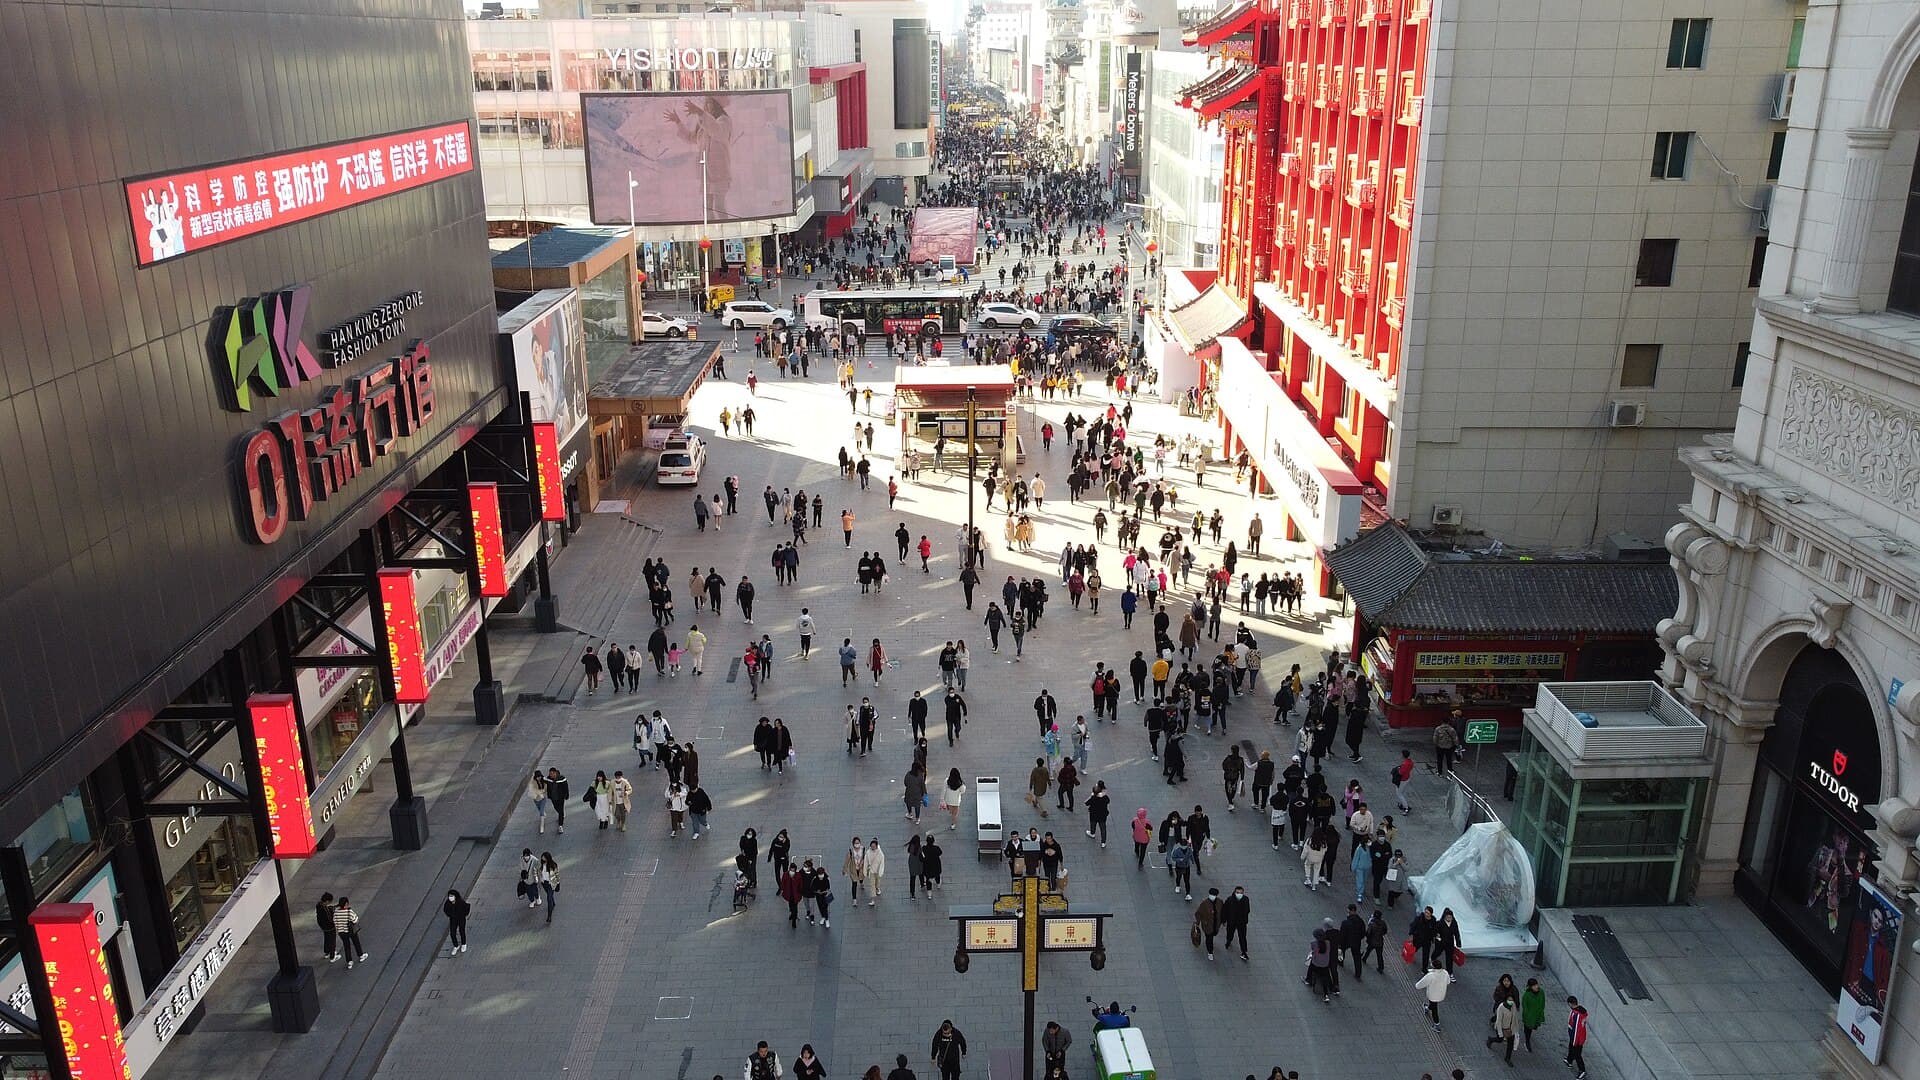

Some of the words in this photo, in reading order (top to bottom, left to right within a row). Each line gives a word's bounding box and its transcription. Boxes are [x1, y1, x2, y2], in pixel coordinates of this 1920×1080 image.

[1125, 71, 1140, 152] Meters/bonwe
[184, 170, 270, 213] 科学防控
[272, 161, 329, 213] 强防护
[336, 149, 386, 196] 不恐慌
[389, 140, 429, 181] 信科学
[432, 131, 468, 170] 不传谣
[189, 200, 274, 239] 新型冠状病毒疫情
[331, 324, 353, 349] HAN
[355, 311, 379, 340] KING
[380, 299, 405, 326] ZERO
[405, 290, 424, 311] ONE
[333, 335, 379, 369] FASHION
[379, 318, 407, 346] TOWN
[1810, 760, 1860, 813] TUDOR
